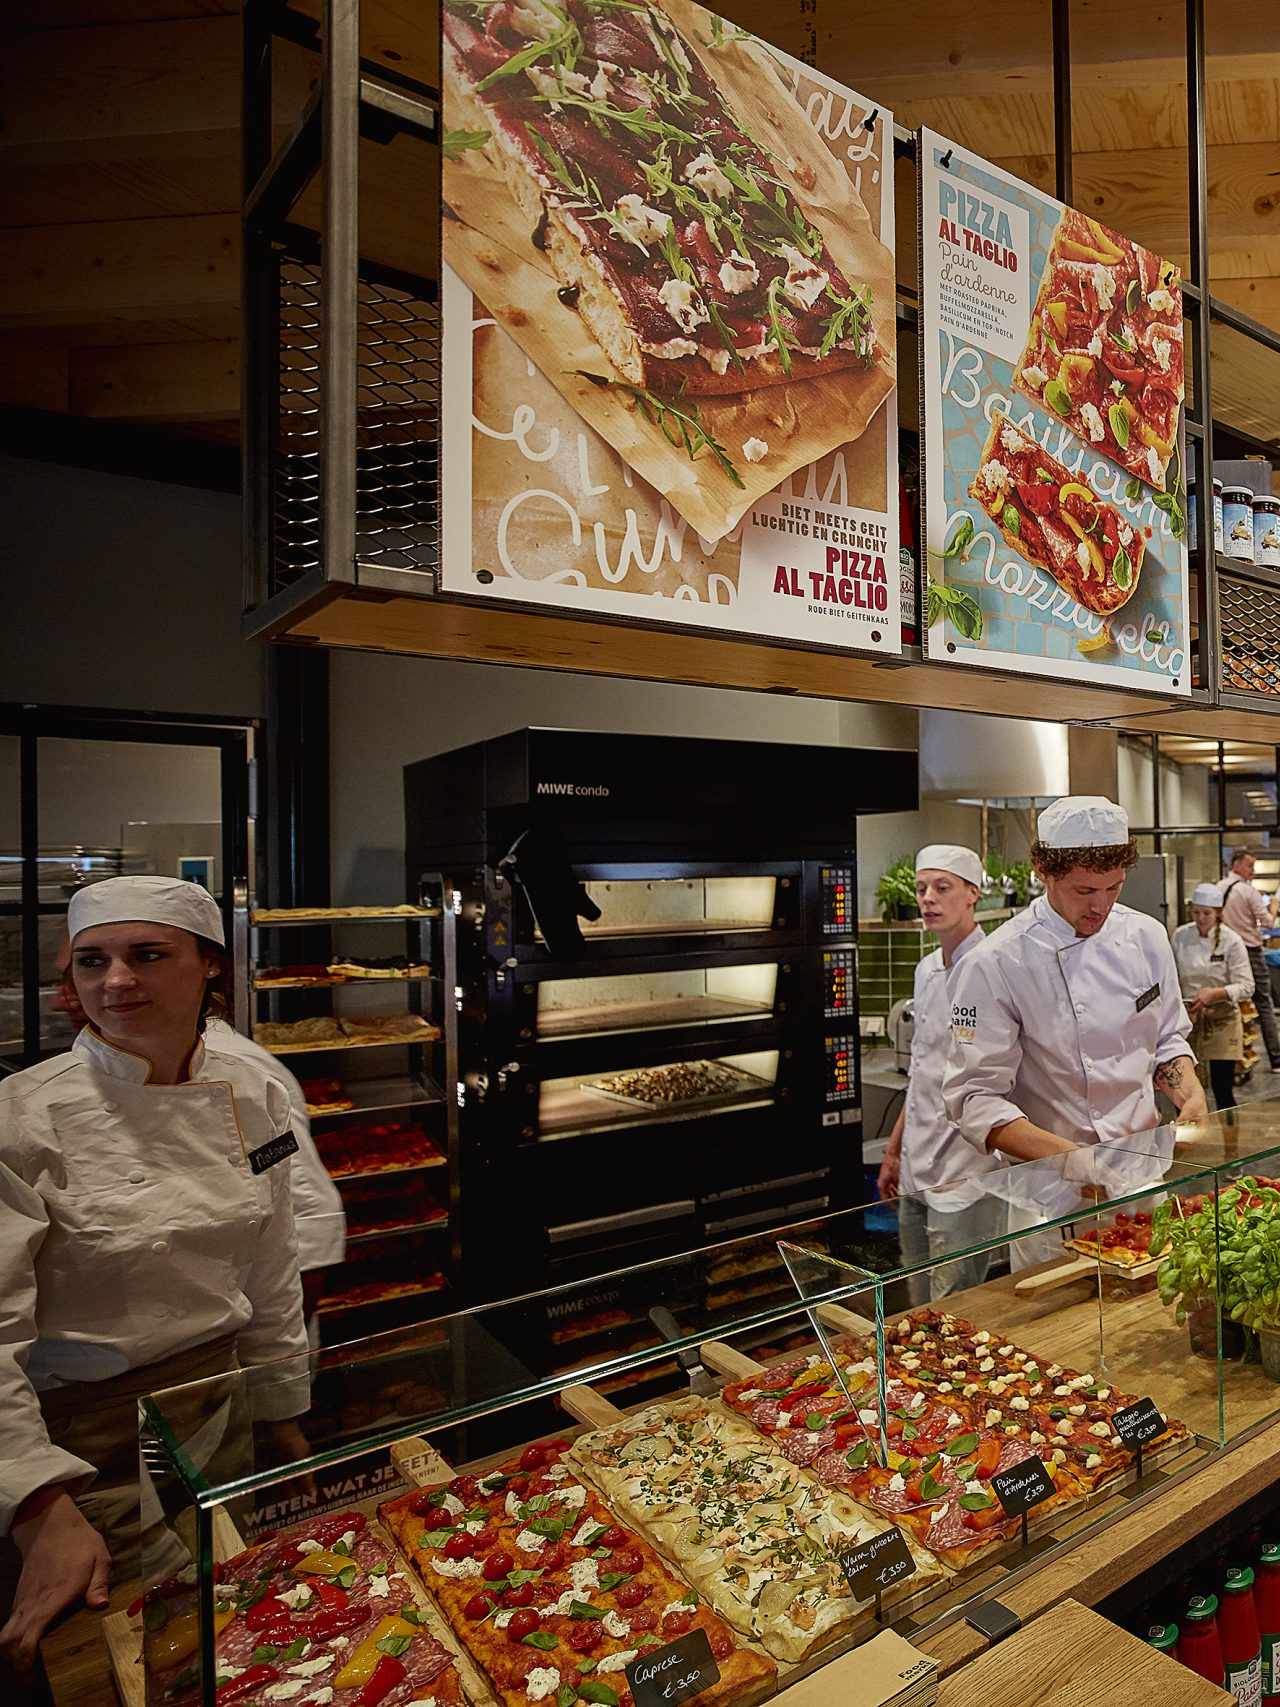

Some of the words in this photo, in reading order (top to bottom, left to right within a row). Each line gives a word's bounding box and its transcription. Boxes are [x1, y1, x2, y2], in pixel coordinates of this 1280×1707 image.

[939, 180, 1013, 249] PIZZA
[938, 242, 978, 272] Pain
[939, 218, 961, 247] AL
[962, 227, 1018, 273] TAGLIO
[939, 282, 952, 293] MET
[953, 288, 980, 305] ROASTED
[980, 300, 1008, 318] PAPRIKA,
[940, 263, 1017, 305] d'ardenne
[940, 293, 1000, 325] BUFFELMOZZARELLA,
[940, 303, 972, 322] BASILICUM
[973, 316, 981, 326] EN
[982, 319, 1014, 340] TOP-NOTCH
[940, 315, 955, 326] PAIN
[955, 320, 988, 339] D'ARDENNE
[752, 512, 809, 536] LUCHTIG
[812, 525, 828, 541] EN
[832, 530, 887, 554] CRUNCHY
[782, 503, 810, 521] BIET
[815, 511, 857, 531] MEETS
[861, 522, 887, 539] GEIT
[826, 546, 888, 584] PIZZA
[773, 565, 805, 597] AL
[809, 571, 888, 611] TAGLIO
[808, 605, 827, 615] RODE
[829, 609, 845, 618] BIET
[847, 611, 889, 625] GEITENKAAS
[537, 783, 574, 795] MIWE
[575, 785, 610, 796] condo
[243, 1491, 317, 1528] WETEN
[322, 1473, 368, 1499] WAT
[372, 1465, 396, 1484] JE
[356, 1486, 378, 1501] NAAR
[378, 1482, 387, 1494] DE
[634, 1653, 684, 1685] Caprese
